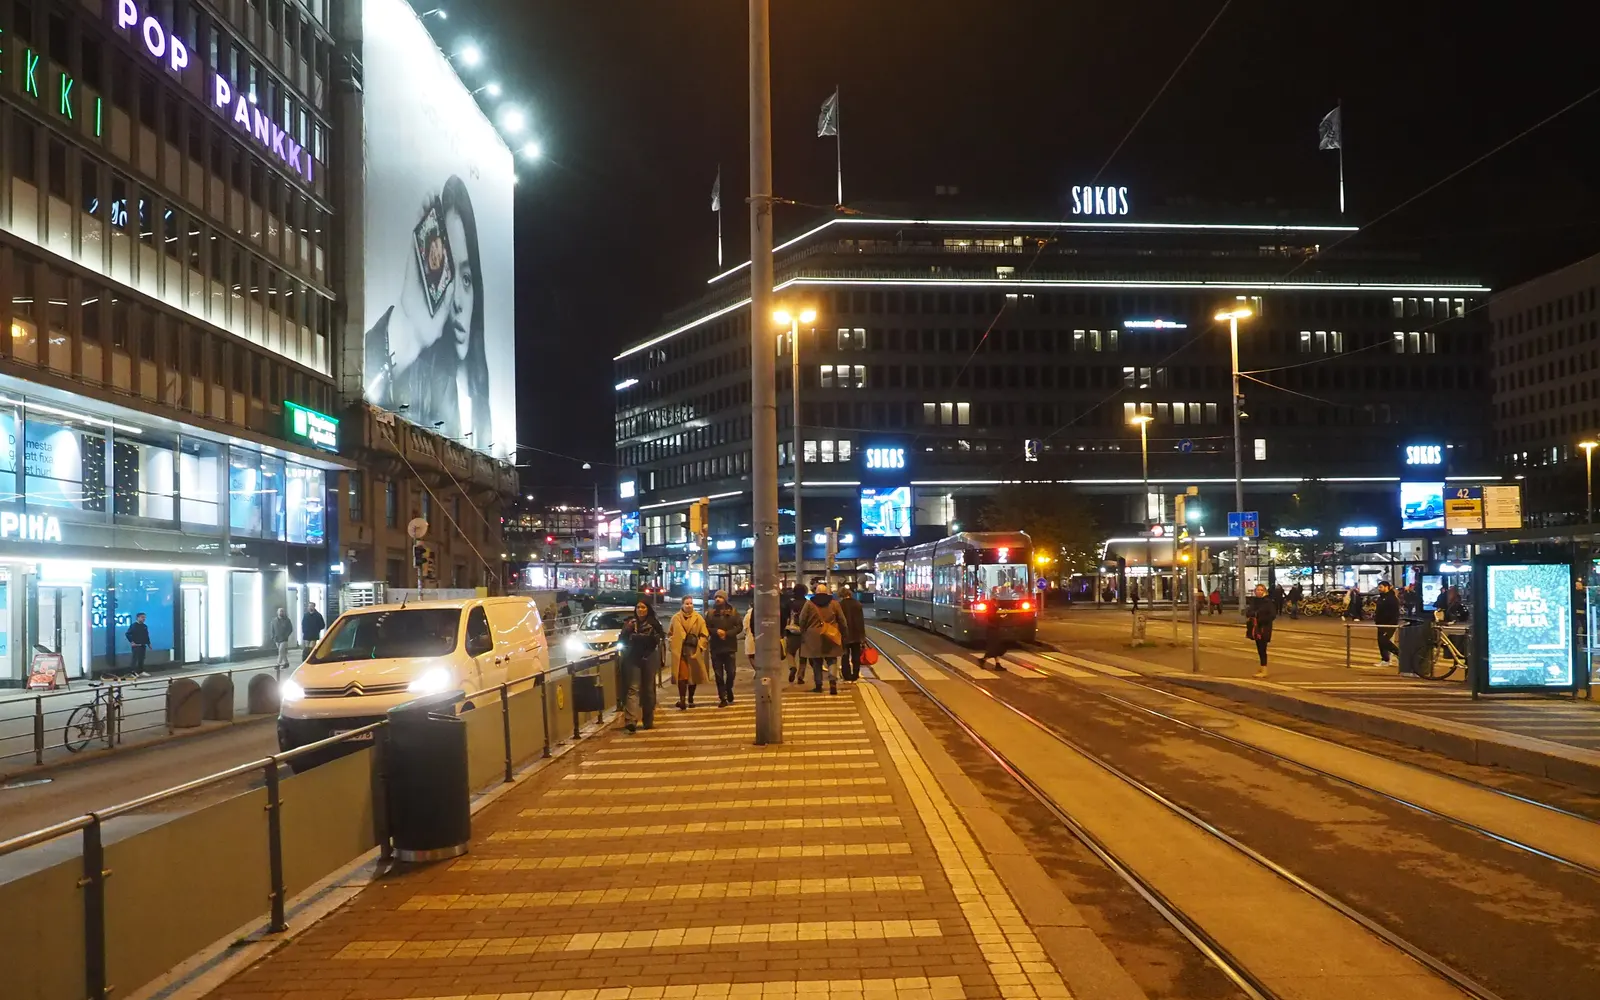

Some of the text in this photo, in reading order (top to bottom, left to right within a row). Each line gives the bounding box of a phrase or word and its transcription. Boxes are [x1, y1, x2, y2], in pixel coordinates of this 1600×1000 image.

[0, 29, 101, 137] KKI
[118, 0, 188, 71] POP
[215, 73, 313, 182] PANKKI
[1072, 185, 1128, 215] SOKOS
[866, 448, 904, 468] SOKOS
[1406, 445, 1441, 464] SOKOS
[1456, 488, 1469, 499] 42
[1, 511, 61, 541] PIHA
